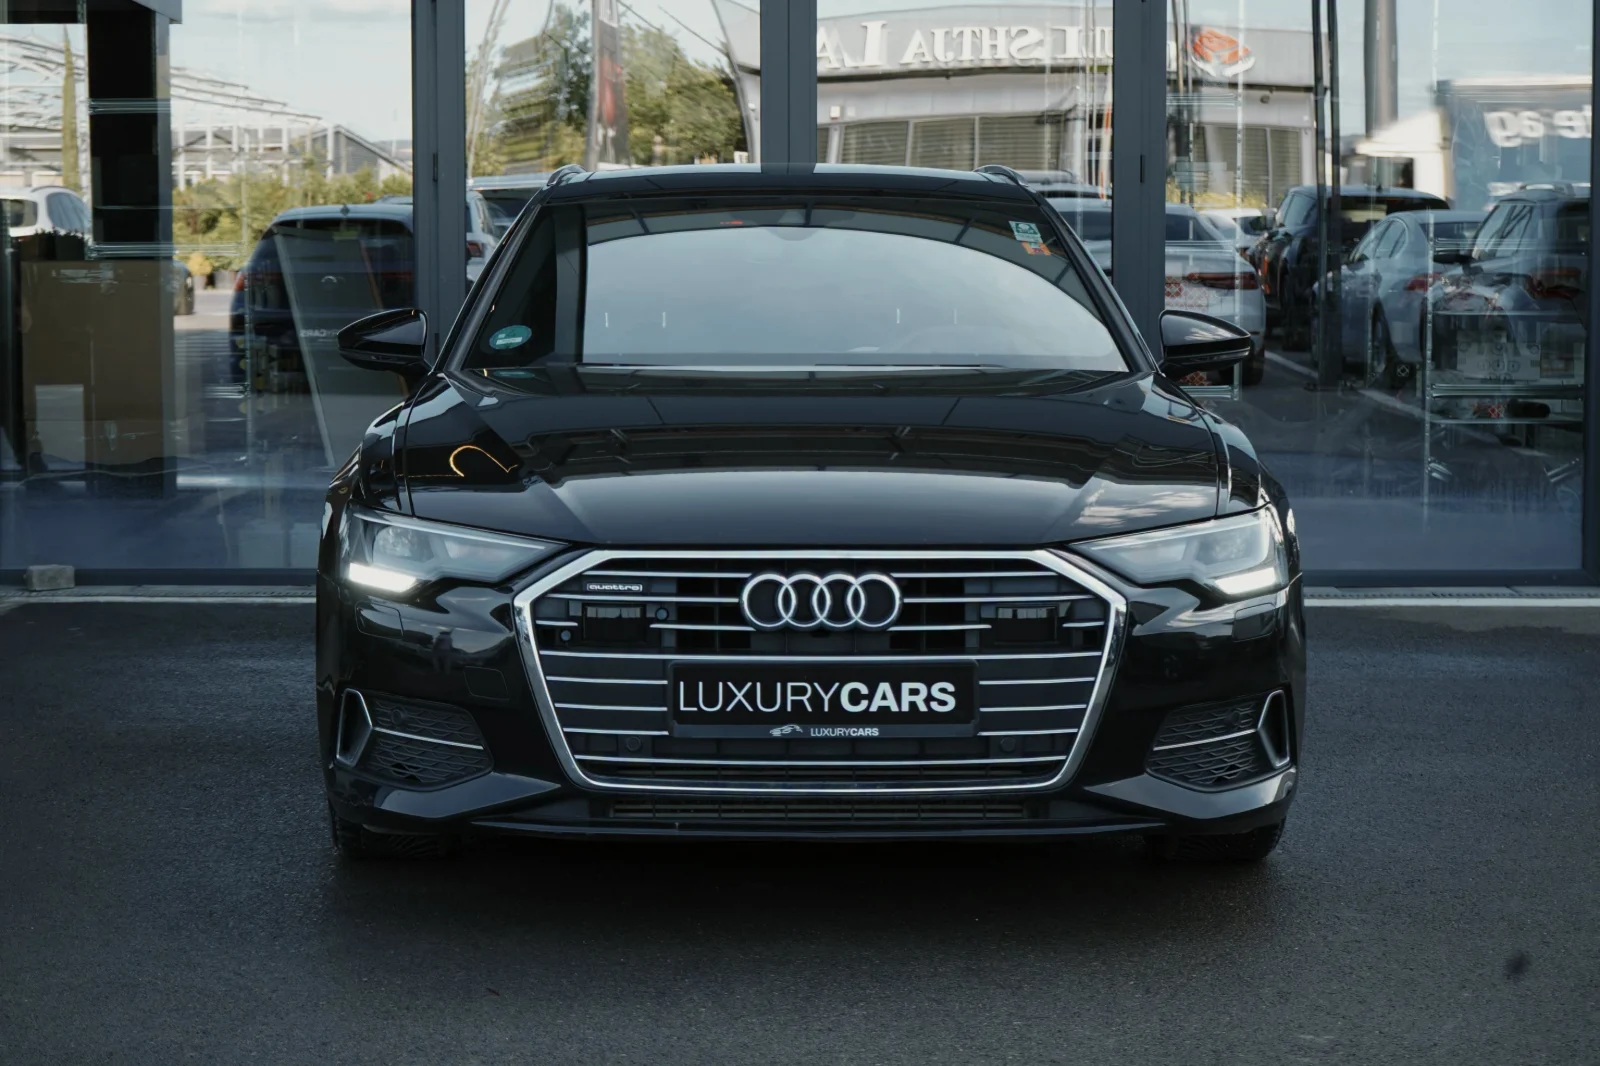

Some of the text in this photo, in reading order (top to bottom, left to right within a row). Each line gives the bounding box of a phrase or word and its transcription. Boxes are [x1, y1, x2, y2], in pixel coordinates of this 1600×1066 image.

[588, 583, 641, 592] quattro
[679, 681, 956, 713] LUXURYCARS
[810, 727, 880, 737] LUXURYCARS
